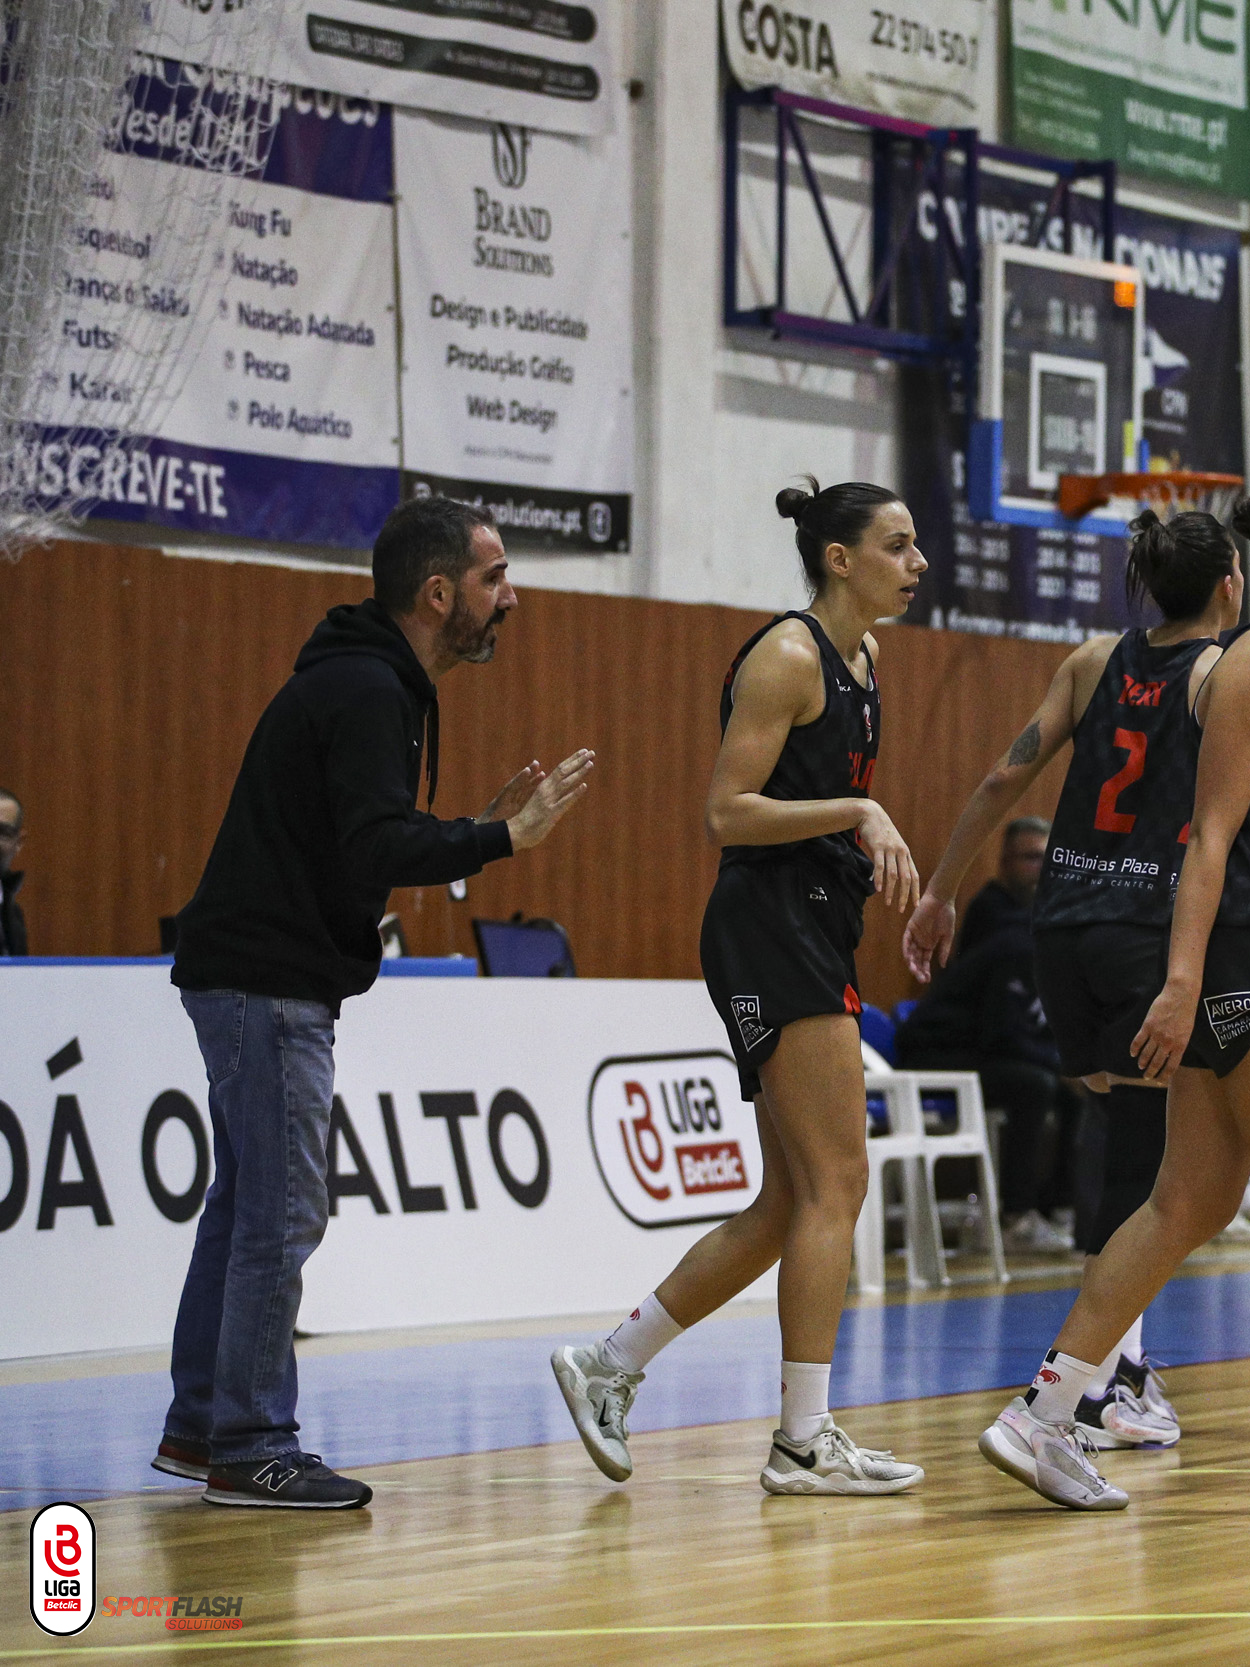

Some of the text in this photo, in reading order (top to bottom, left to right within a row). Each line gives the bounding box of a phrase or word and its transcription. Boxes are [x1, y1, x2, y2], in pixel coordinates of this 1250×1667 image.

[739, 0, 839, 78] COSTA
[270, 209, 292, 237] Fu
[237, 300, 303, 341] Natação
[429, 294, 487, 331] Design
[490, 304, 500, 325] e
[243, 351, 291, 383] Pesca
[248, 400, 284, 431] Polo
[465, 394, 506, 423] Web
[1094, 727, 1148, 833] 2
[1051, 846, 1160, 876] Glicínias Plaza
[329, 1087, 550, 1217] ALTO
